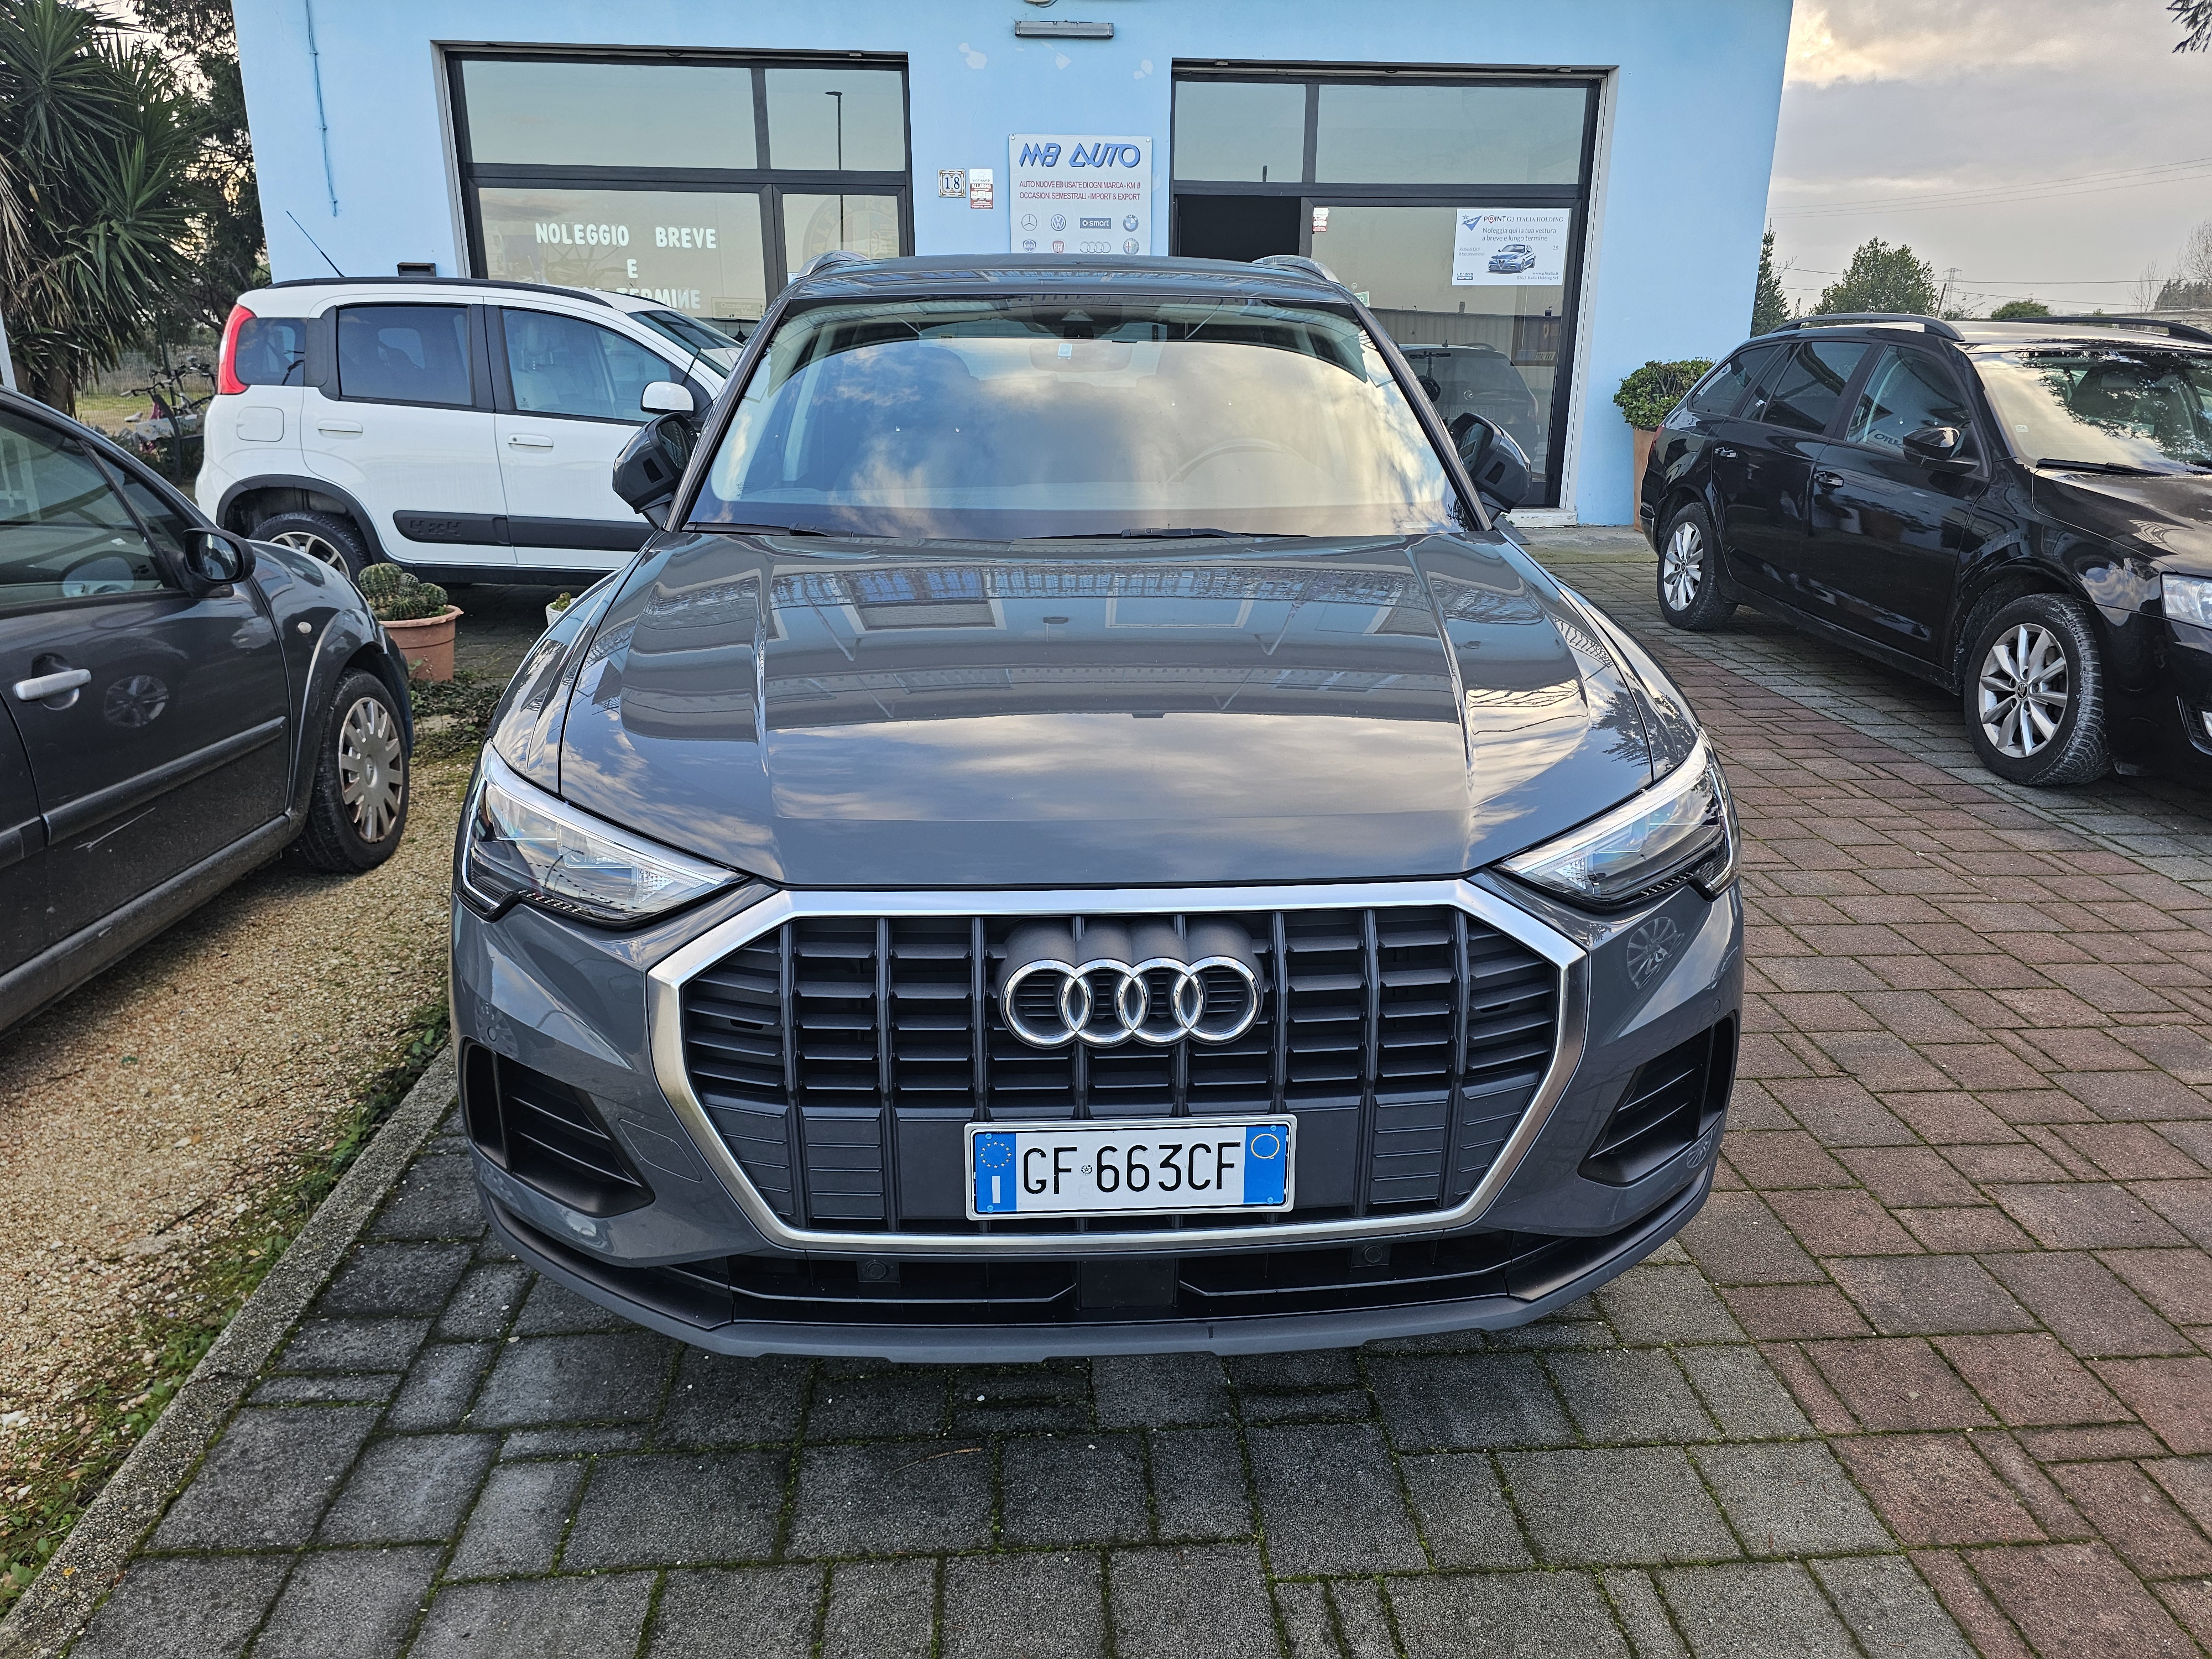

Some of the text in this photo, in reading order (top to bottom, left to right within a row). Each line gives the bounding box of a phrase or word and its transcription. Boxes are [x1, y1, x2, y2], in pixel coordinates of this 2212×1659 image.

[1068, 143, 1141, 168] AUTO
[945, 176, 960, 190] 18
[1484, 215, 1506, 223] POINT
[535, 222, 717, 249] NOLEGGIO BREVE
[627, 258, 638, 279] E
[1022, 1141, 1241, 1194] GF 663CF
